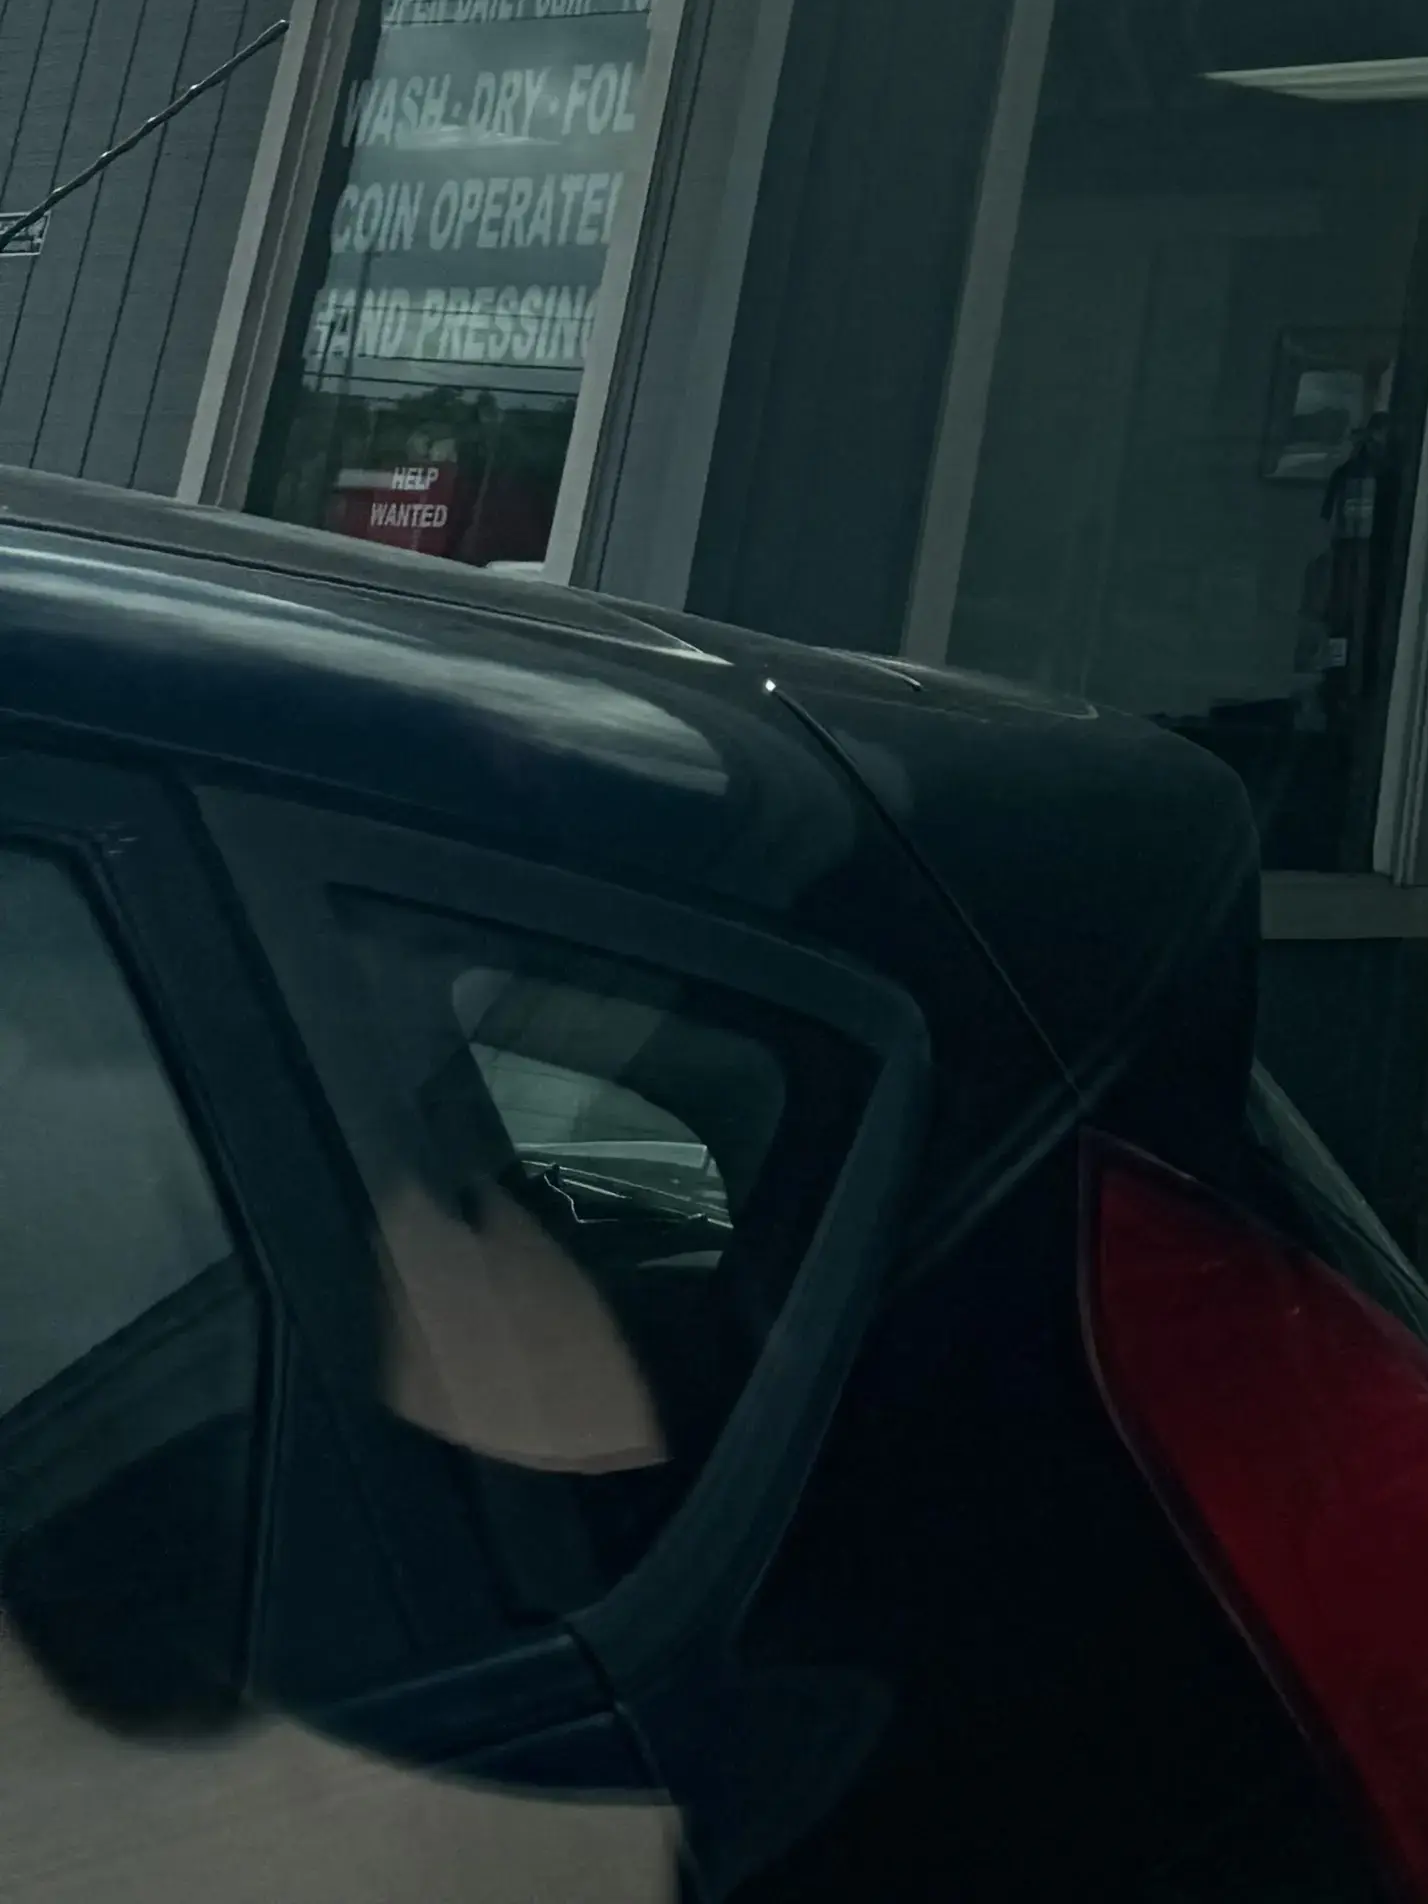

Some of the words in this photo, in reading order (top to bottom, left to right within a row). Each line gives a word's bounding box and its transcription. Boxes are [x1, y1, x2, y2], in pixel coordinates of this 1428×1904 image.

[341, 73, 452, 148] WASH
[468, 65, 553, 139] DRY
[330, 181, 425, 254] COIN
[392, 467, 440, 490] HELP
[370, 502, 449, 528] WANTED
